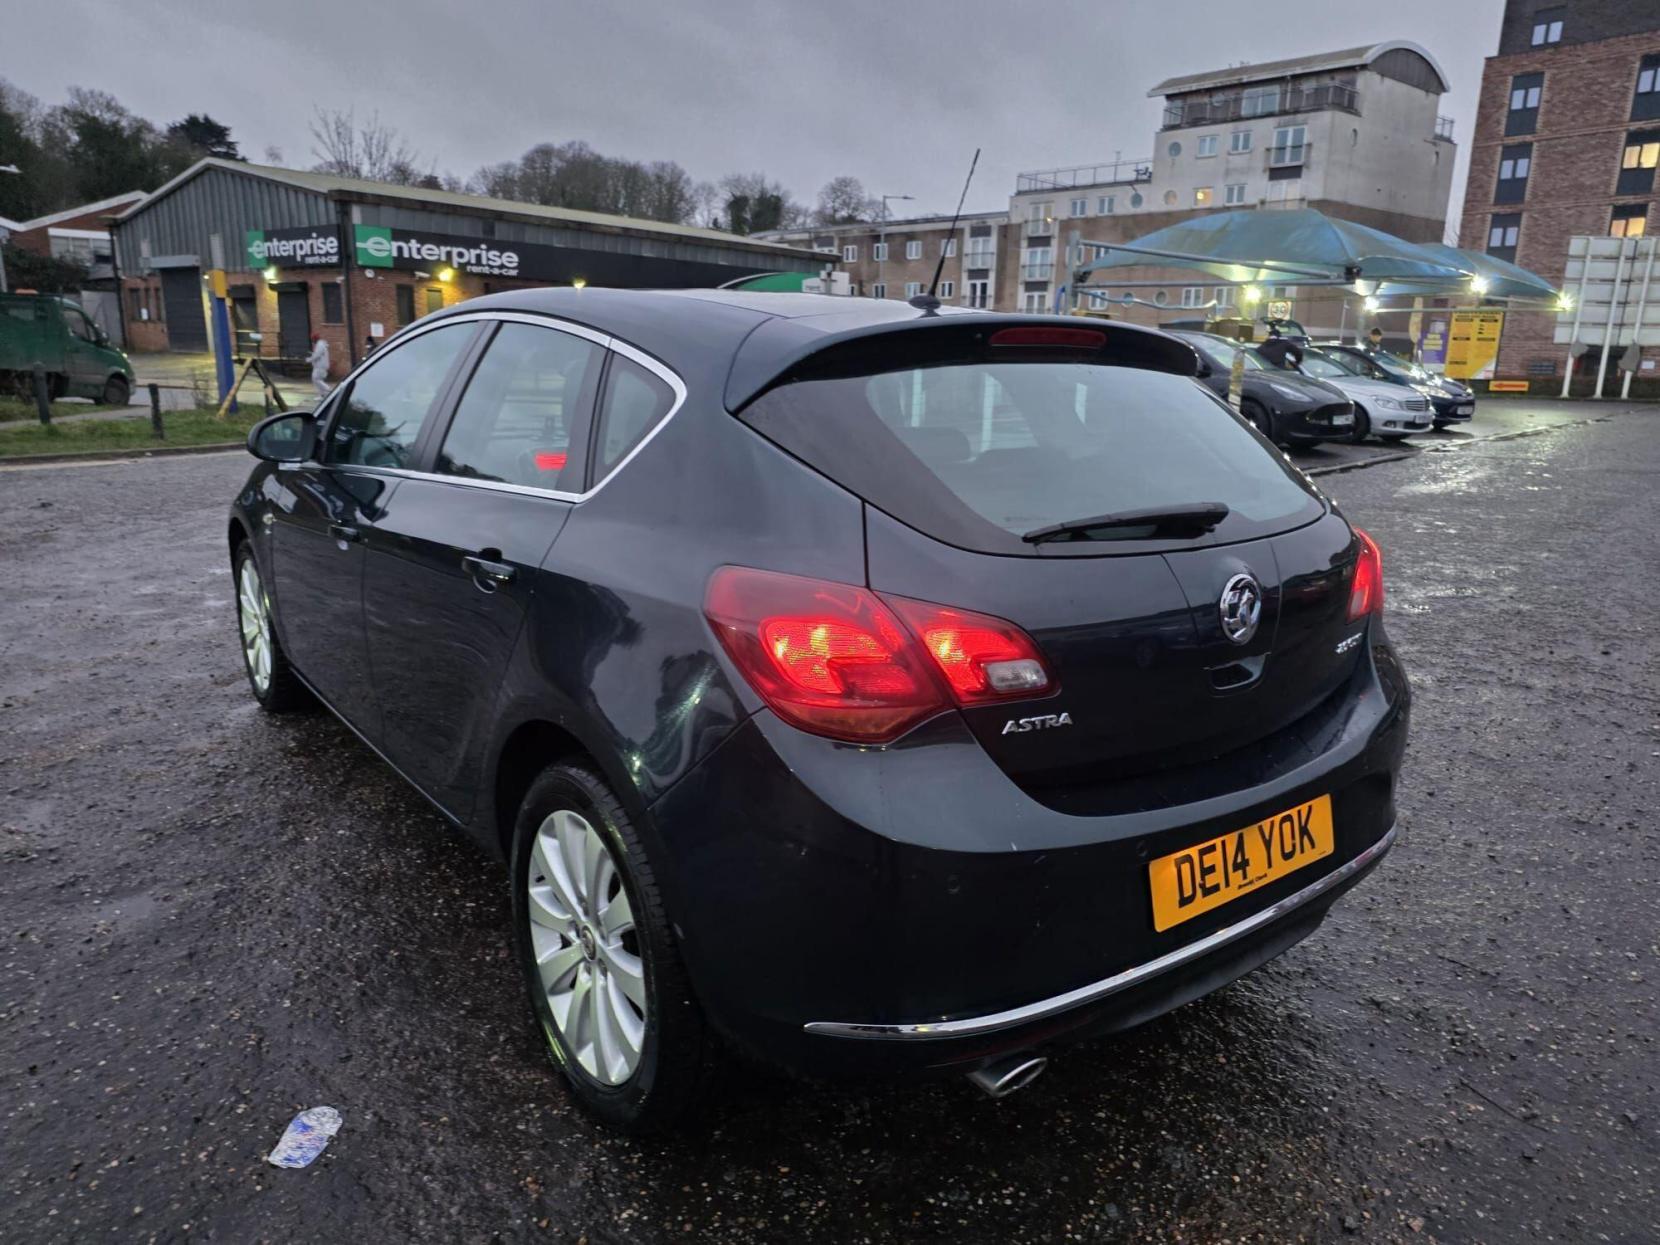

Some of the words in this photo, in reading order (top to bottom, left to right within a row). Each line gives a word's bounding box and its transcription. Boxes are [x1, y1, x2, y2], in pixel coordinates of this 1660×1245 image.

[249, 233, 338, 262] enterprise
[304, 255, 339, 265] rent-a-car
[357, 235, 519, 268] enterprise
[466, 265, 520, 277] rent-a-car
[1001, 712, 1073, 735] ASTRA
[1174, 832, 1250, 909] DE14
[1258, 805, 1316, 870] YOK
